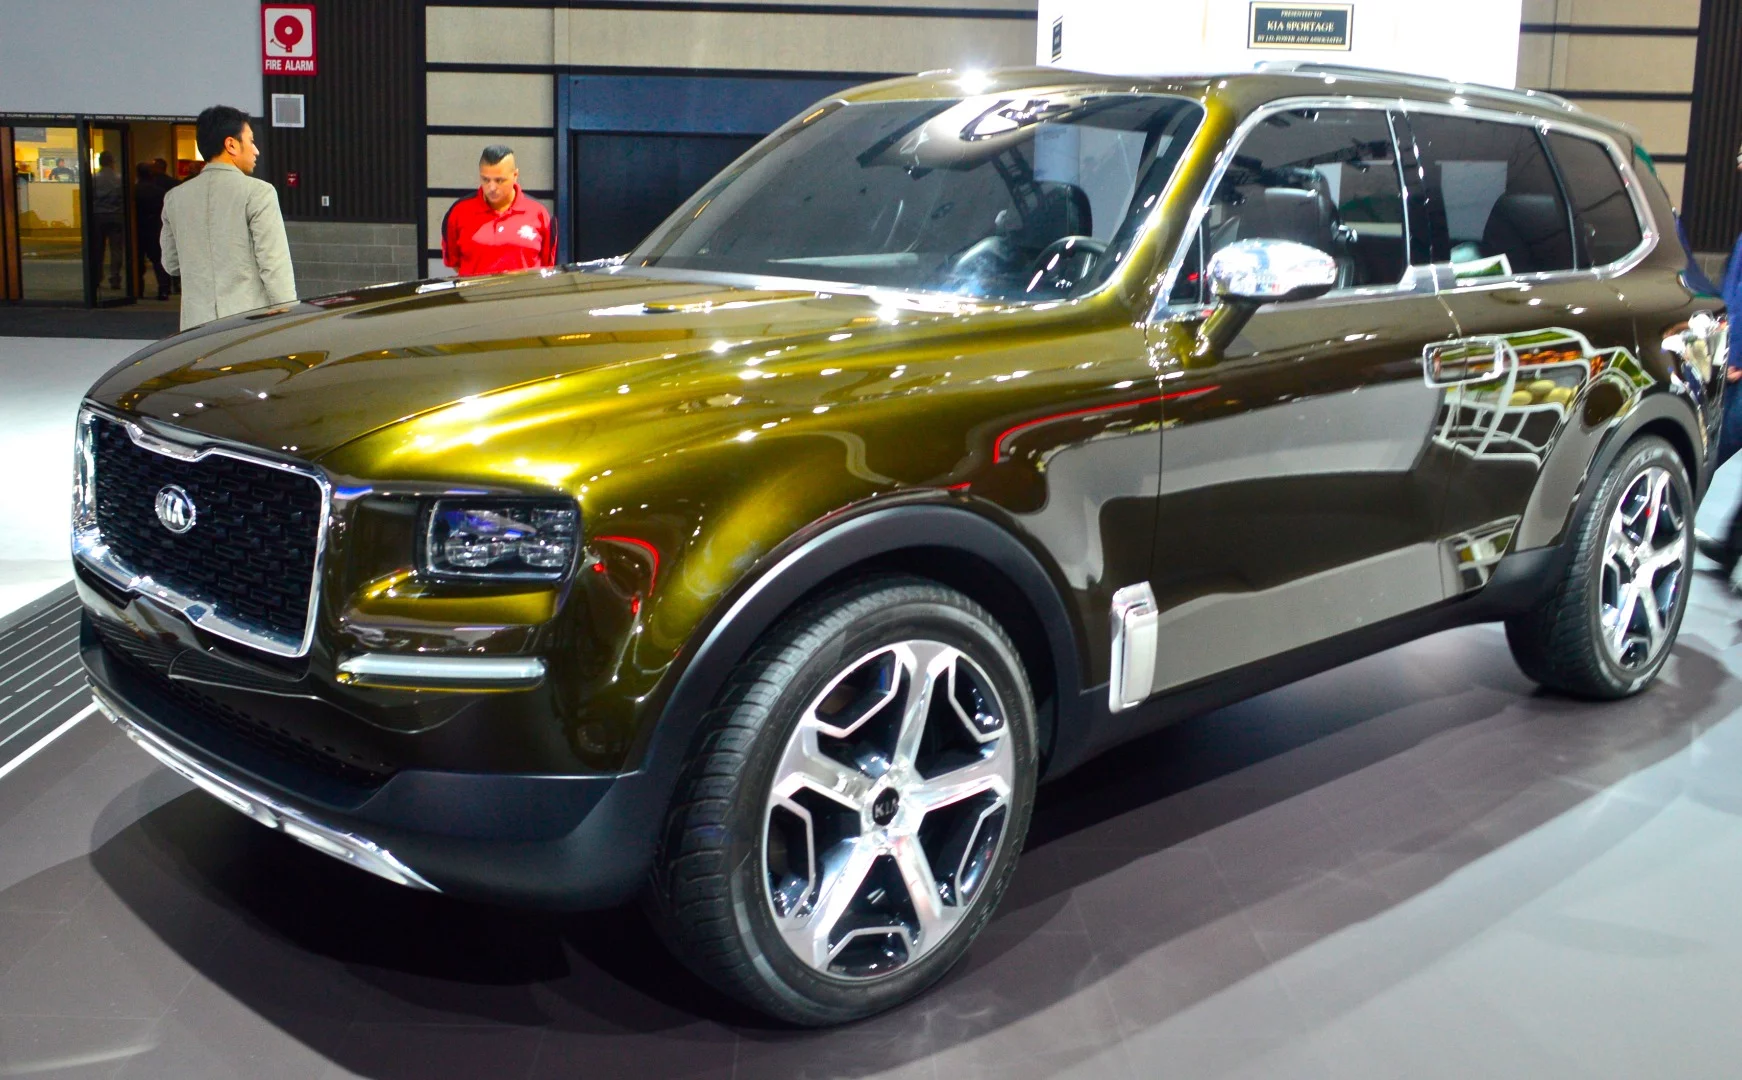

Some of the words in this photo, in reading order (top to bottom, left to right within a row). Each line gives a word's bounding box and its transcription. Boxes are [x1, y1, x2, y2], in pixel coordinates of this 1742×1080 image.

[1267, 20, 1284, 31] KIA
[1286, 20, 1334, 32] SPORTAGE
[265, 59, 282, 70] FIRE
[284, 59, 314, 71] ALARM
[875, 797, 899, 818] KIA
